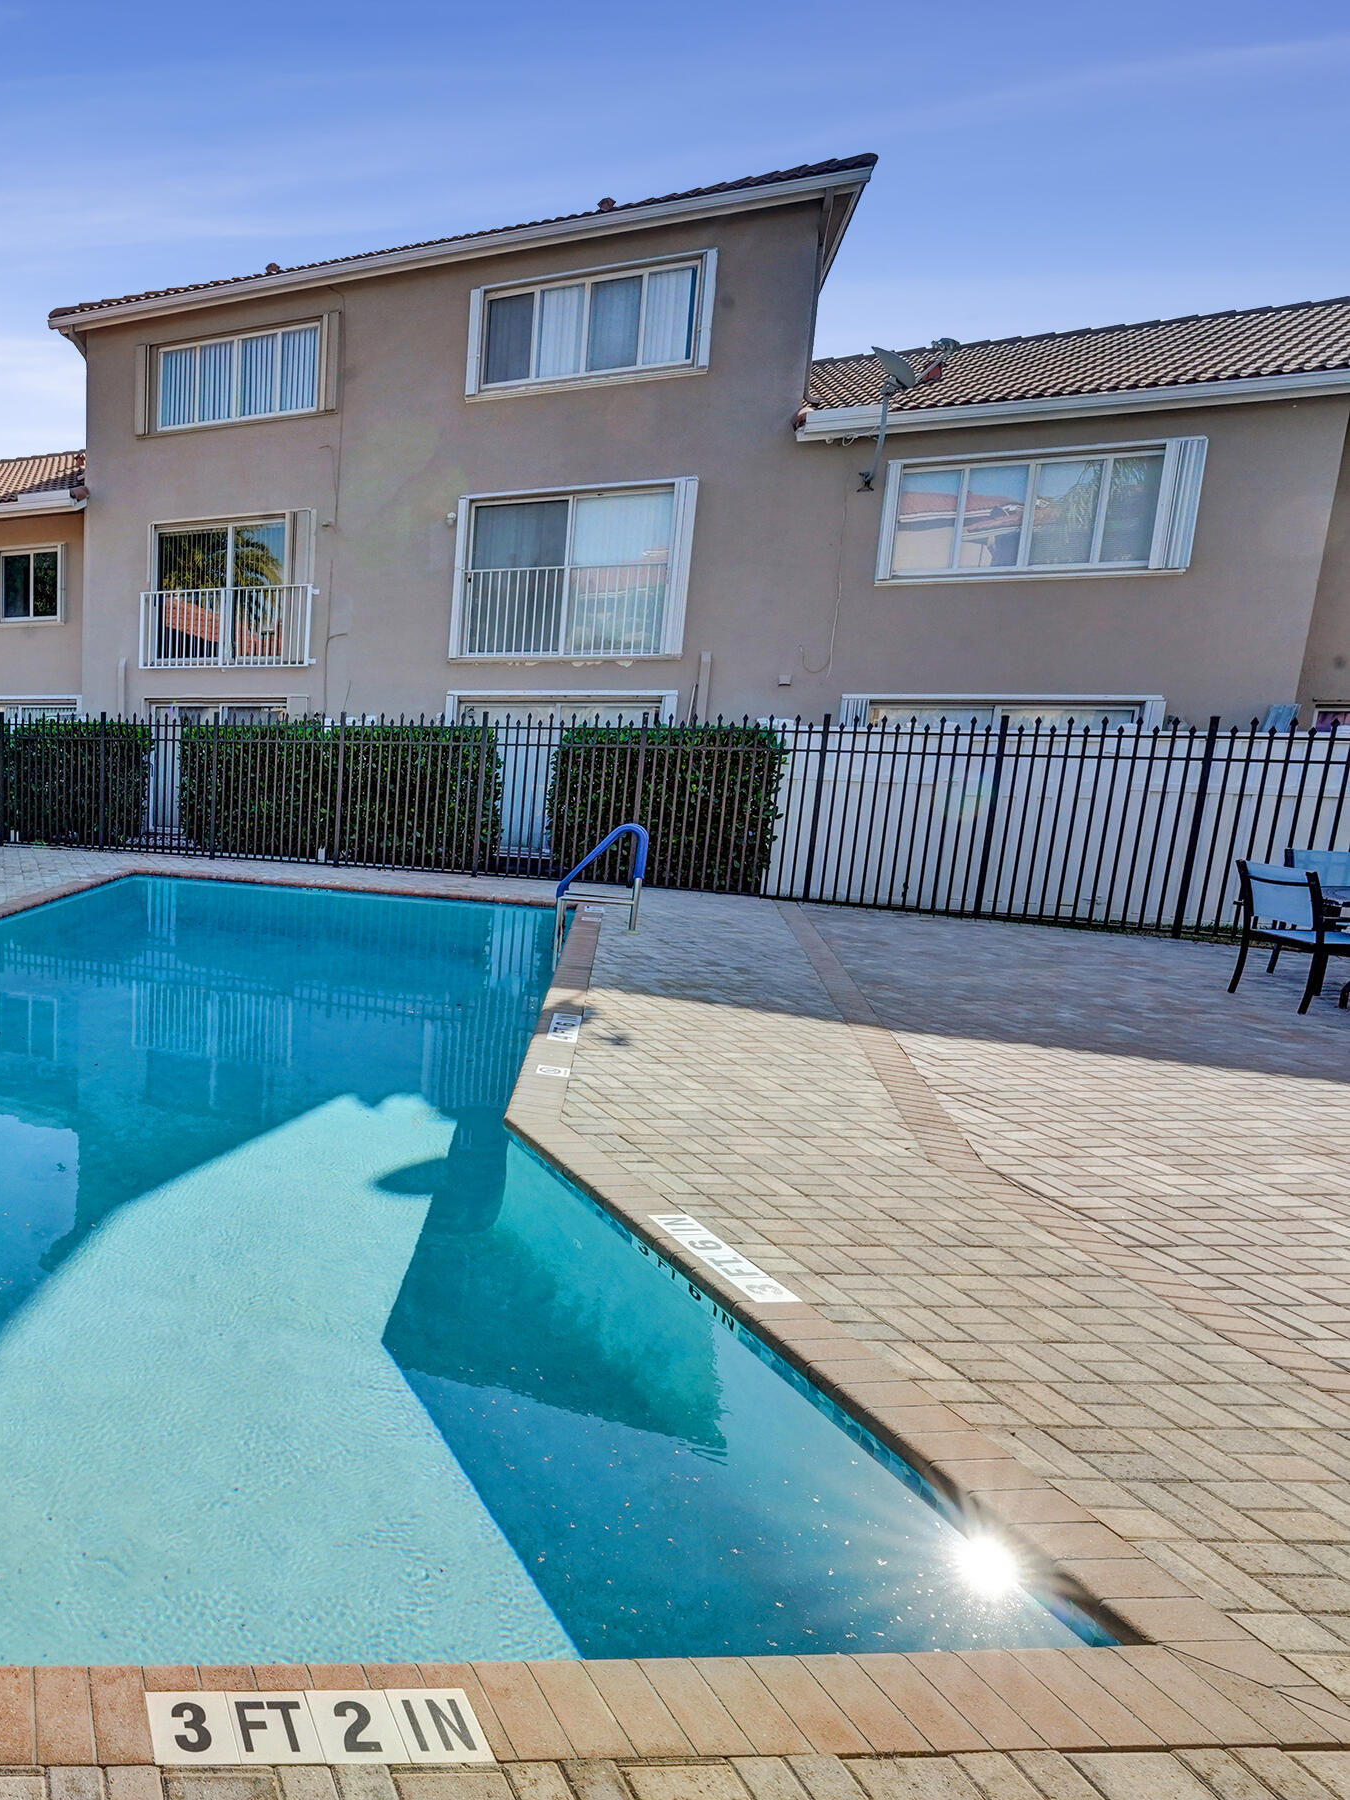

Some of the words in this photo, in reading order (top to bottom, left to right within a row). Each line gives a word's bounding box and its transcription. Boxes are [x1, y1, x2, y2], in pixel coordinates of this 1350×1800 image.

[657, 1217, 702, 1232] IN
[687, 1239, 723, 1251] 6
[707, 1256, 760, 1277] FT
[745, 1283, 785, 1296] 3
[170, 1701, 212, 1753] 3
[234, 1701, 301, 1753] FT
[333, 1700, 384, 1753] 2
[401, 1698, 478, 1752] IN
